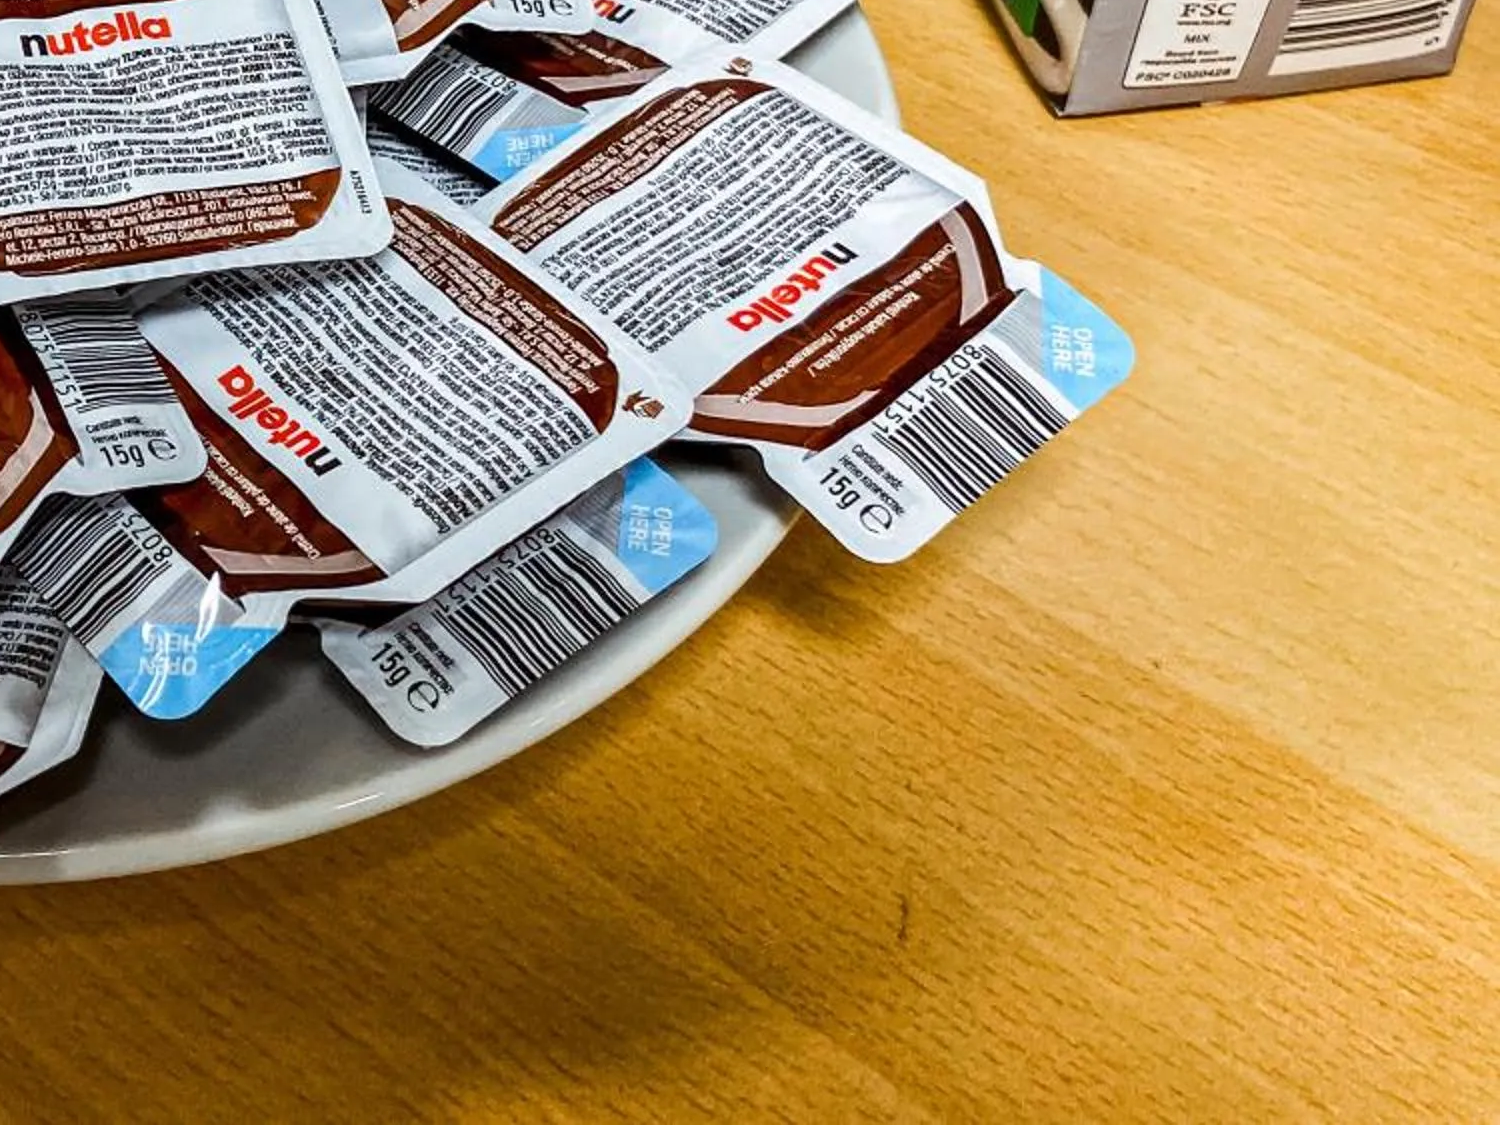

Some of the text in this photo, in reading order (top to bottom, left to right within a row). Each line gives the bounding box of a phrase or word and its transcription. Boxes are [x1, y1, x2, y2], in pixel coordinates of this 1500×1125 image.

[19, 11, 172, 58] nutella
[1180, 3, 1237, 18] FSC
[506, 132, 555, 151] HERE
[726, 242, 860, 332] nutella
[17, 310, 80, 410] 8075 1151
[1050, 325, 1073, 375] HERE
[1071, 326, 1098, 378] OPEN
[871, 343, 983, 436] 8075 1151
[215, 363, 345, 479] nutella
[99, 443, 146, 468] 15g
[818, 465, 862, 511] 15g
[120, 513, 174, 564] 8075
[628, 504, 652, 552] HERE
[650, 505, 674, 558] OPEN
[370, 642, 412, 688] 15g
